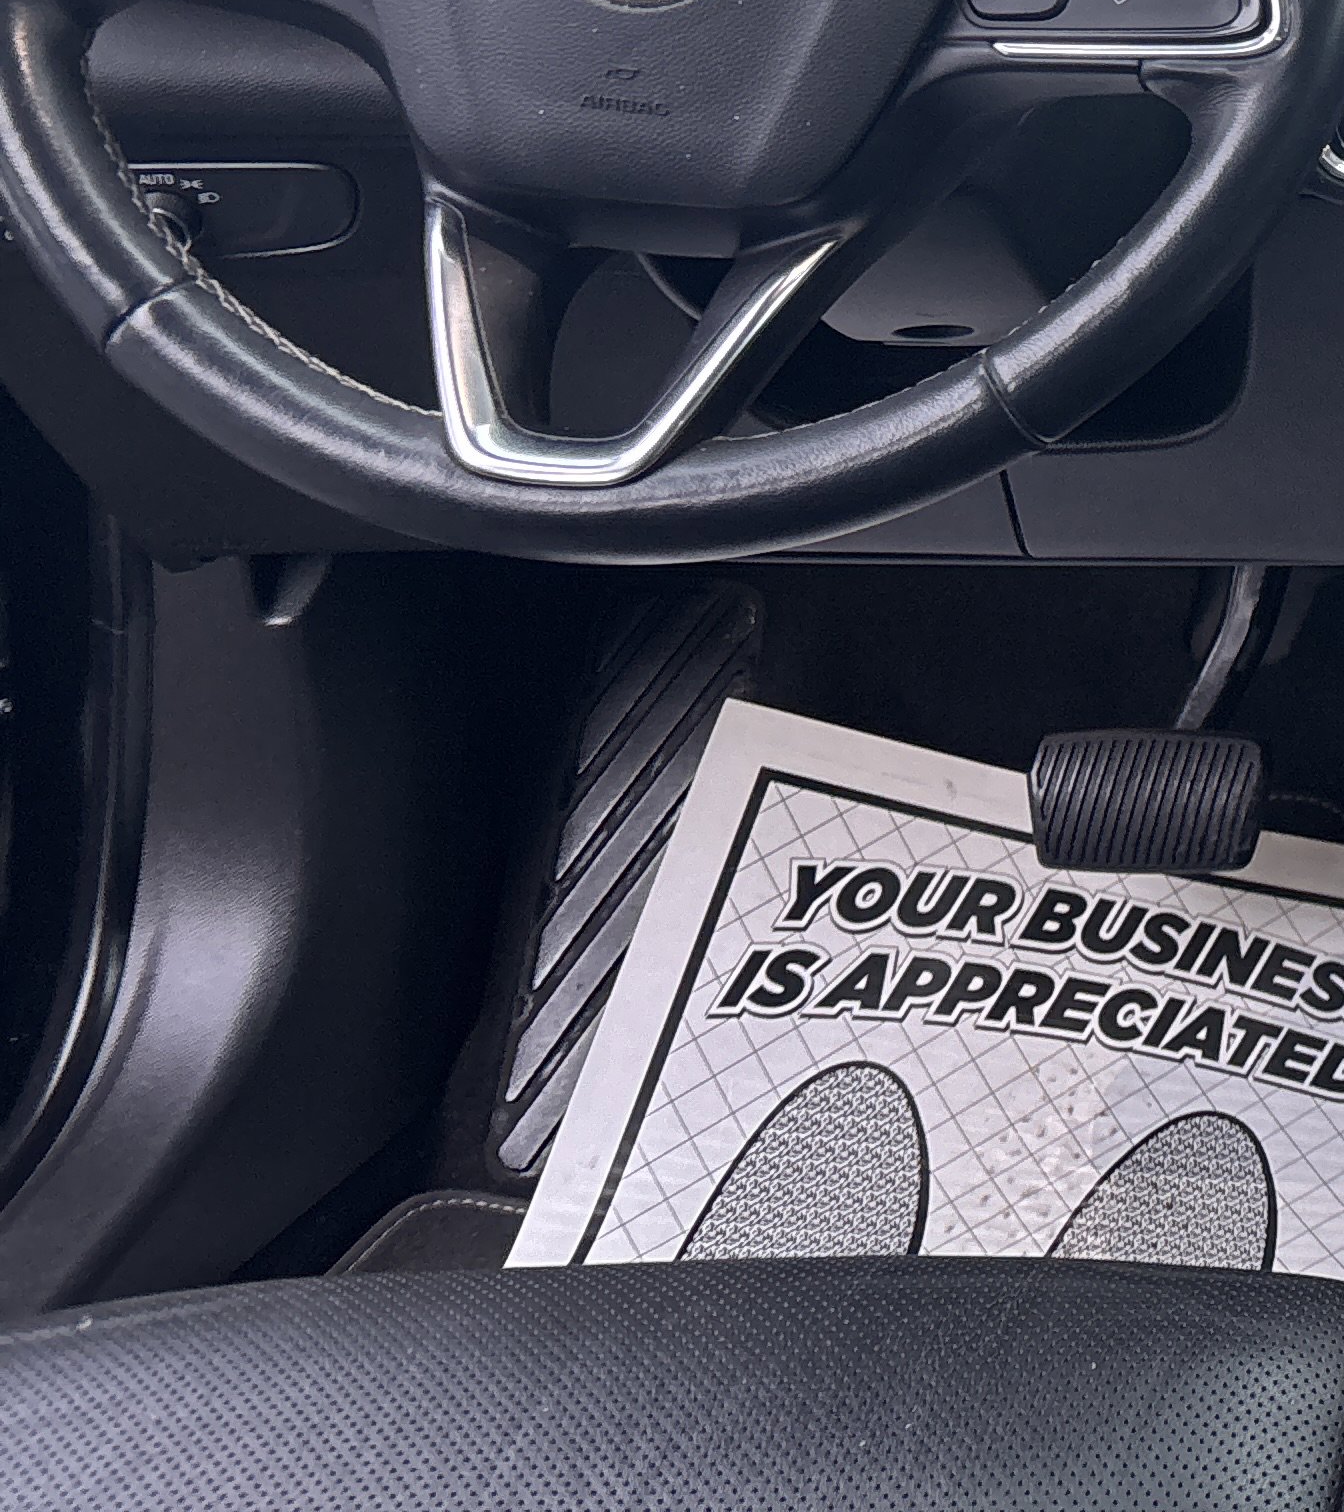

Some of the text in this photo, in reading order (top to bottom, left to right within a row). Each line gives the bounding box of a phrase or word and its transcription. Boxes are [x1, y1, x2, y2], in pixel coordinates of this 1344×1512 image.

[580, 95, 670, 117] AIRBAG
[139, 174, 175, 185] AUTO
[776, 861, 1019, 944] YOUR
[712, 948, 824, 1018] IS
